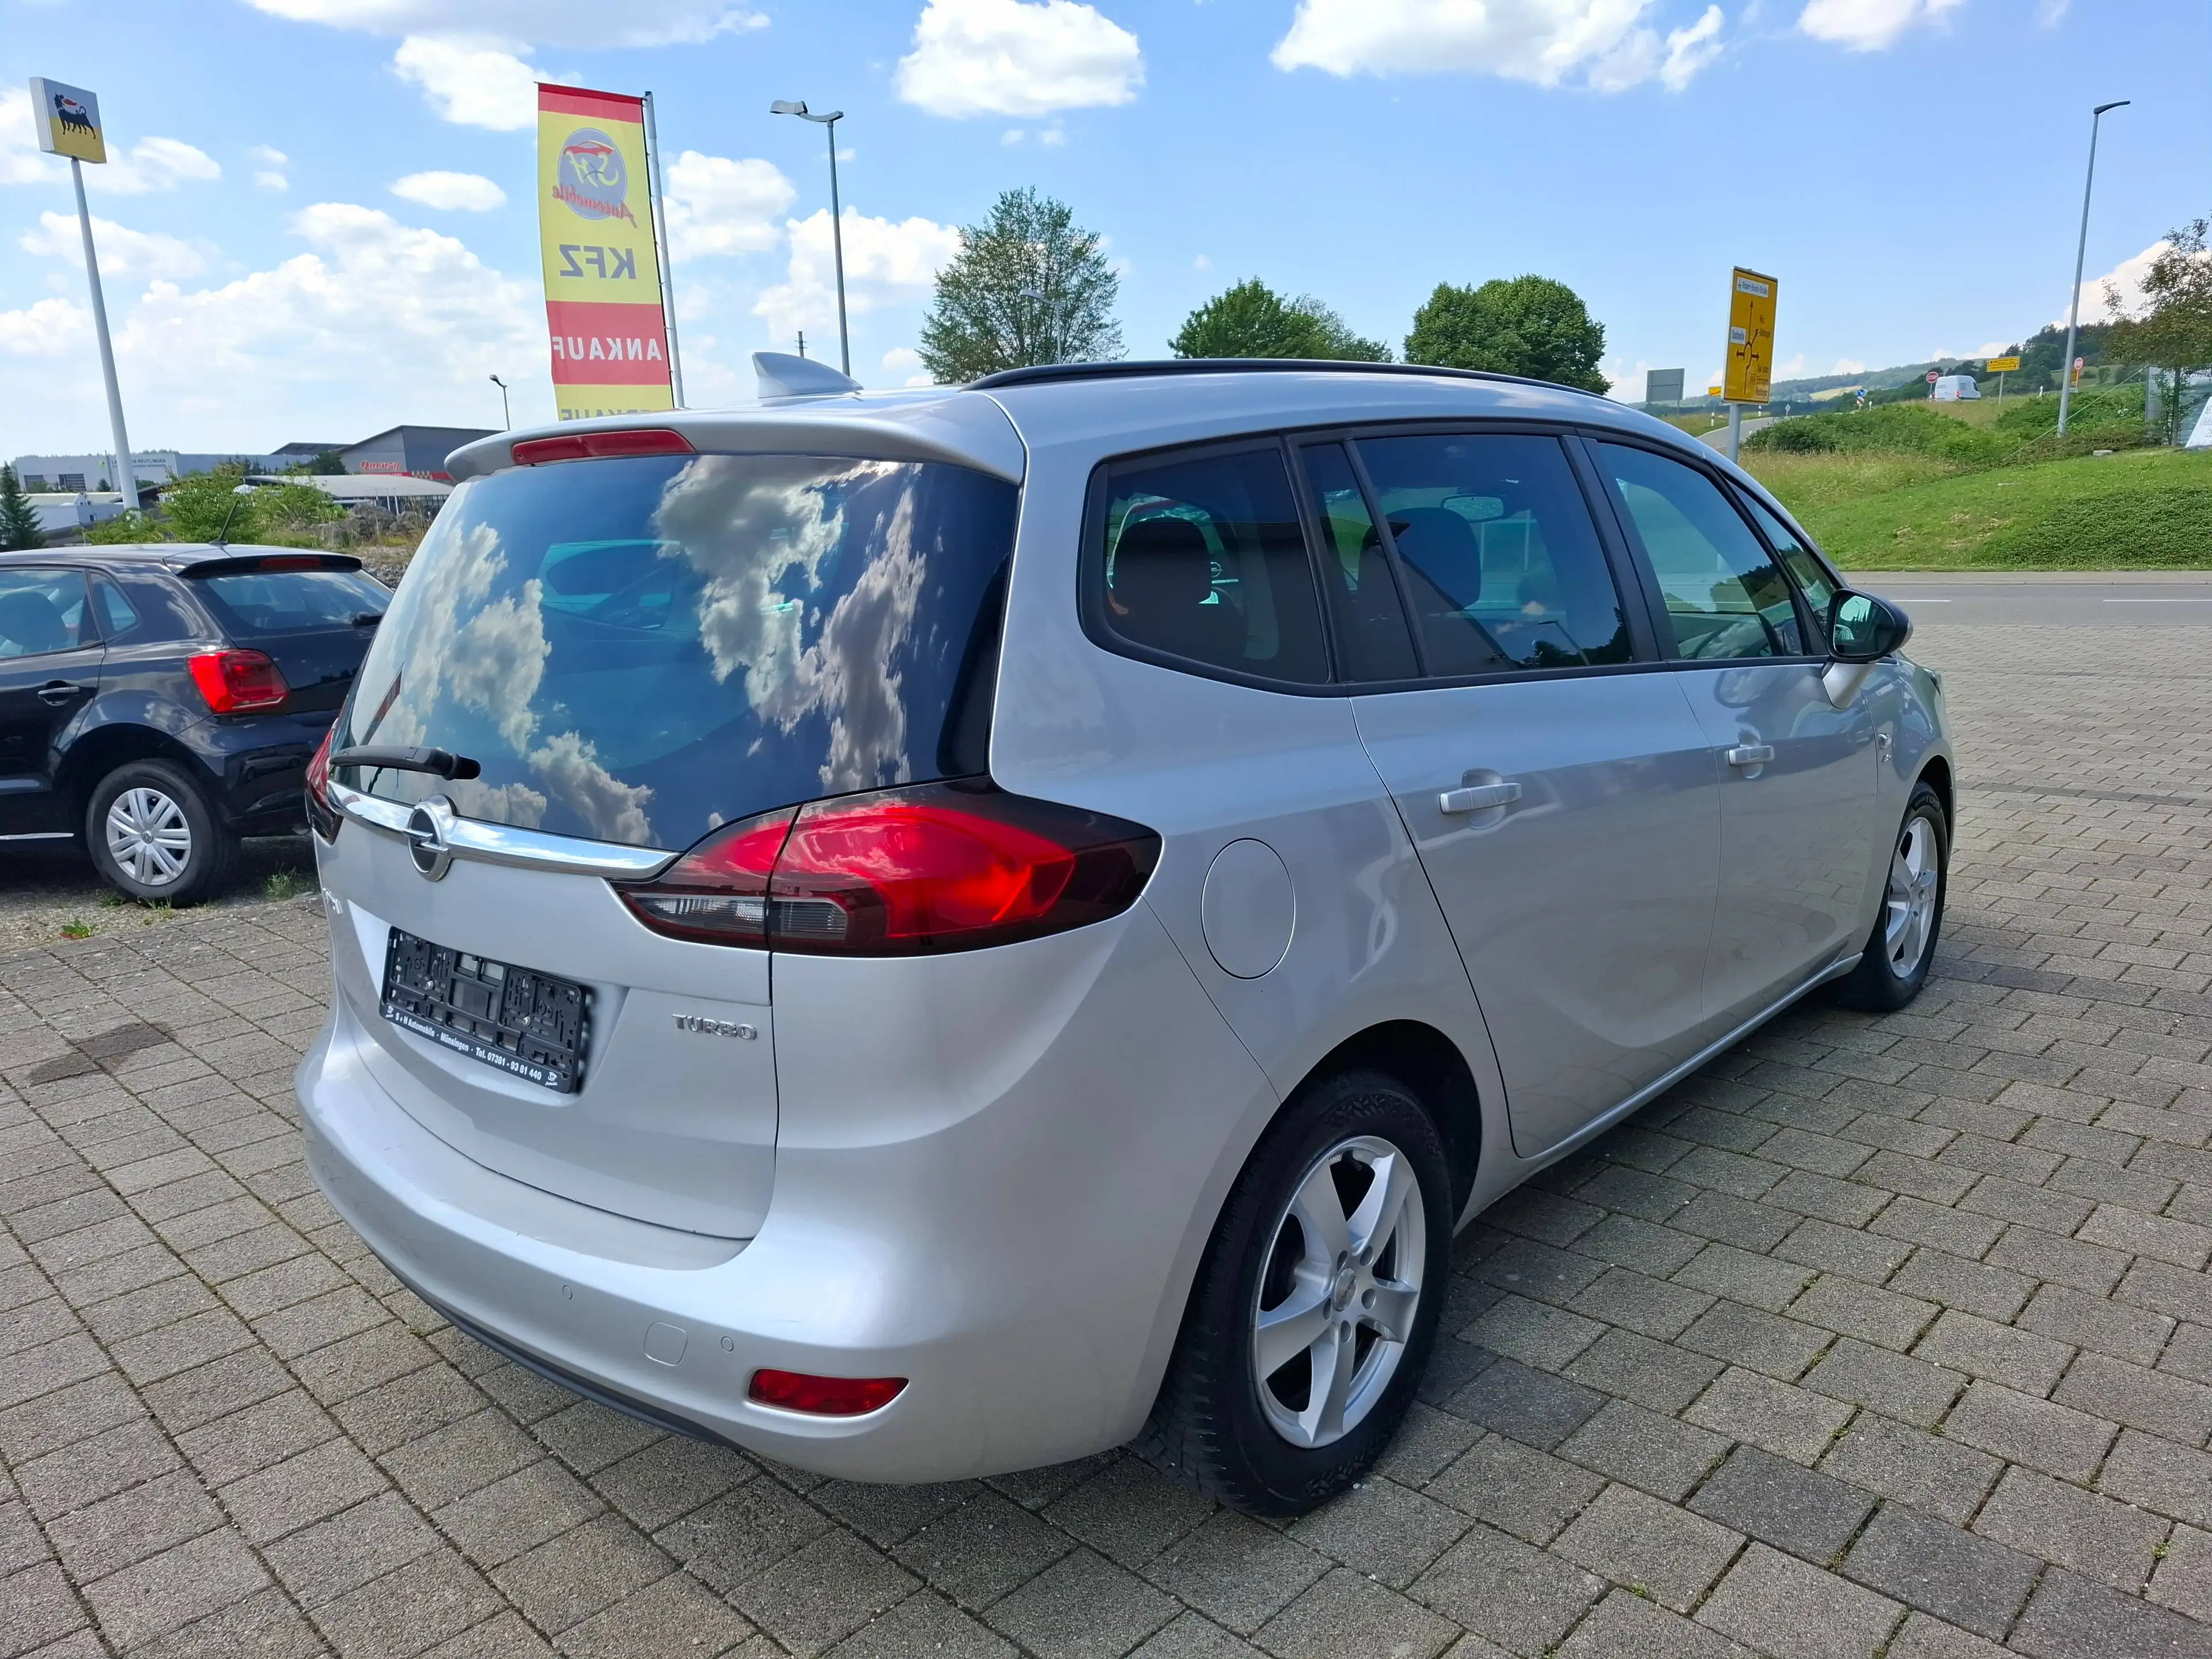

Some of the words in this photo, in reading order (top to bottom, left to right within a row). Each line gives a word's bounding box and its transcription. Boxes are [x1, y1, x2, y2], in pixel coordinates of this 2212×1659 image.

[395, 1012, 399, 1021] S
[403, 1016, 408, 1024] H
[408, 1018, 435, 1037] Automobile
[440, 1032, 469, 1052] Münsingen
[476, 1047, 486, 1059] Tel.
[487, 1052, 506, 1066] 07381
[529, 1069, 541, 1080] 440
[671, 1013, 757, 1040] TURBO
